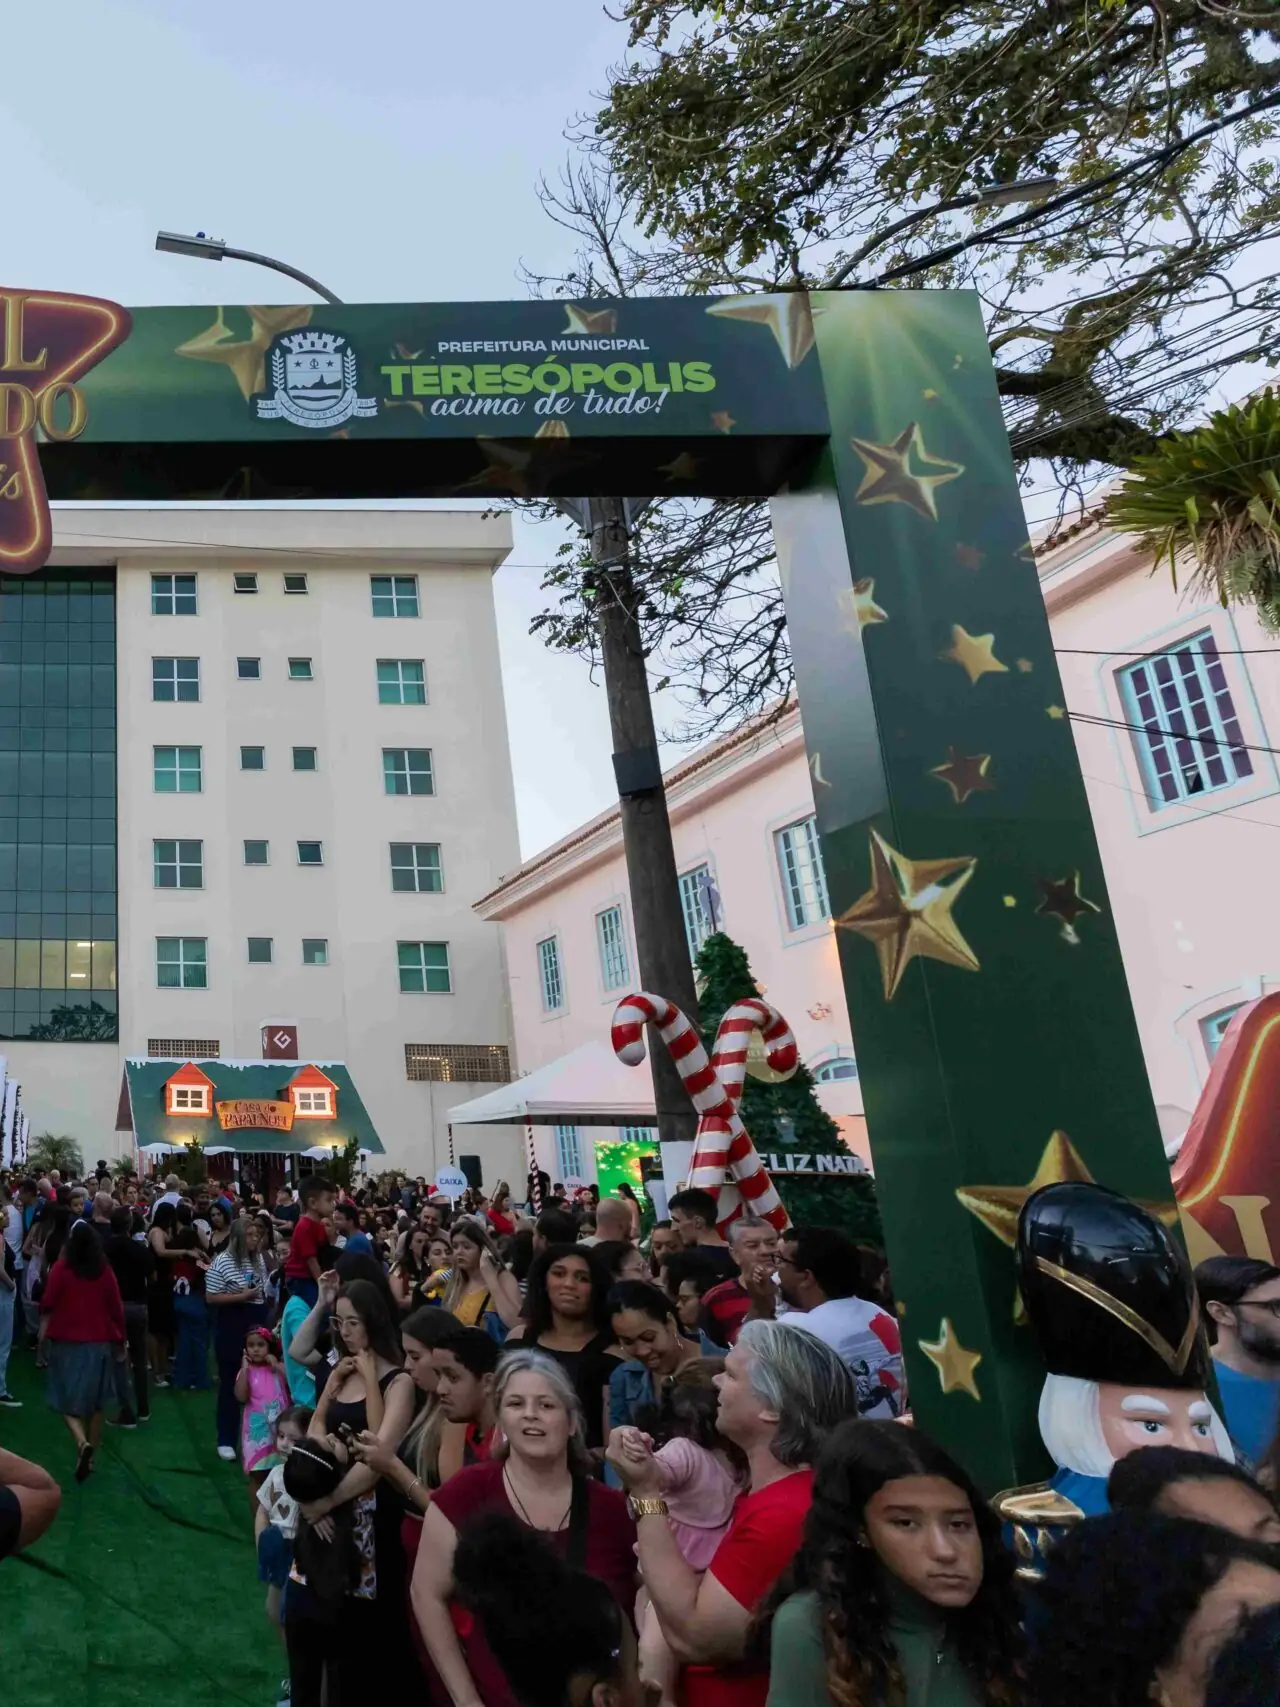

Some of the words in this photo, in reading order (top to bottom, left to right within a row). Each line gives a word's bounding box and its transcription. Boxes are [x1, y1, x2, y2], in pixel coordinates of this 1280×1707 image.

[437, 340, 547, 353] PREFEITURA
[551, 339, 650, 352] MUNICIPAL
[380, 355, 717, 396] TERESÓPOLIS
[429, 392, 527, 417] acima
[533, 389, 577, 415] de
[581, 386, 669, 415] tudo!
[757, 1153, 814, 1172] ELIZ
[439, 1177, 464, 1187] CAIXA
